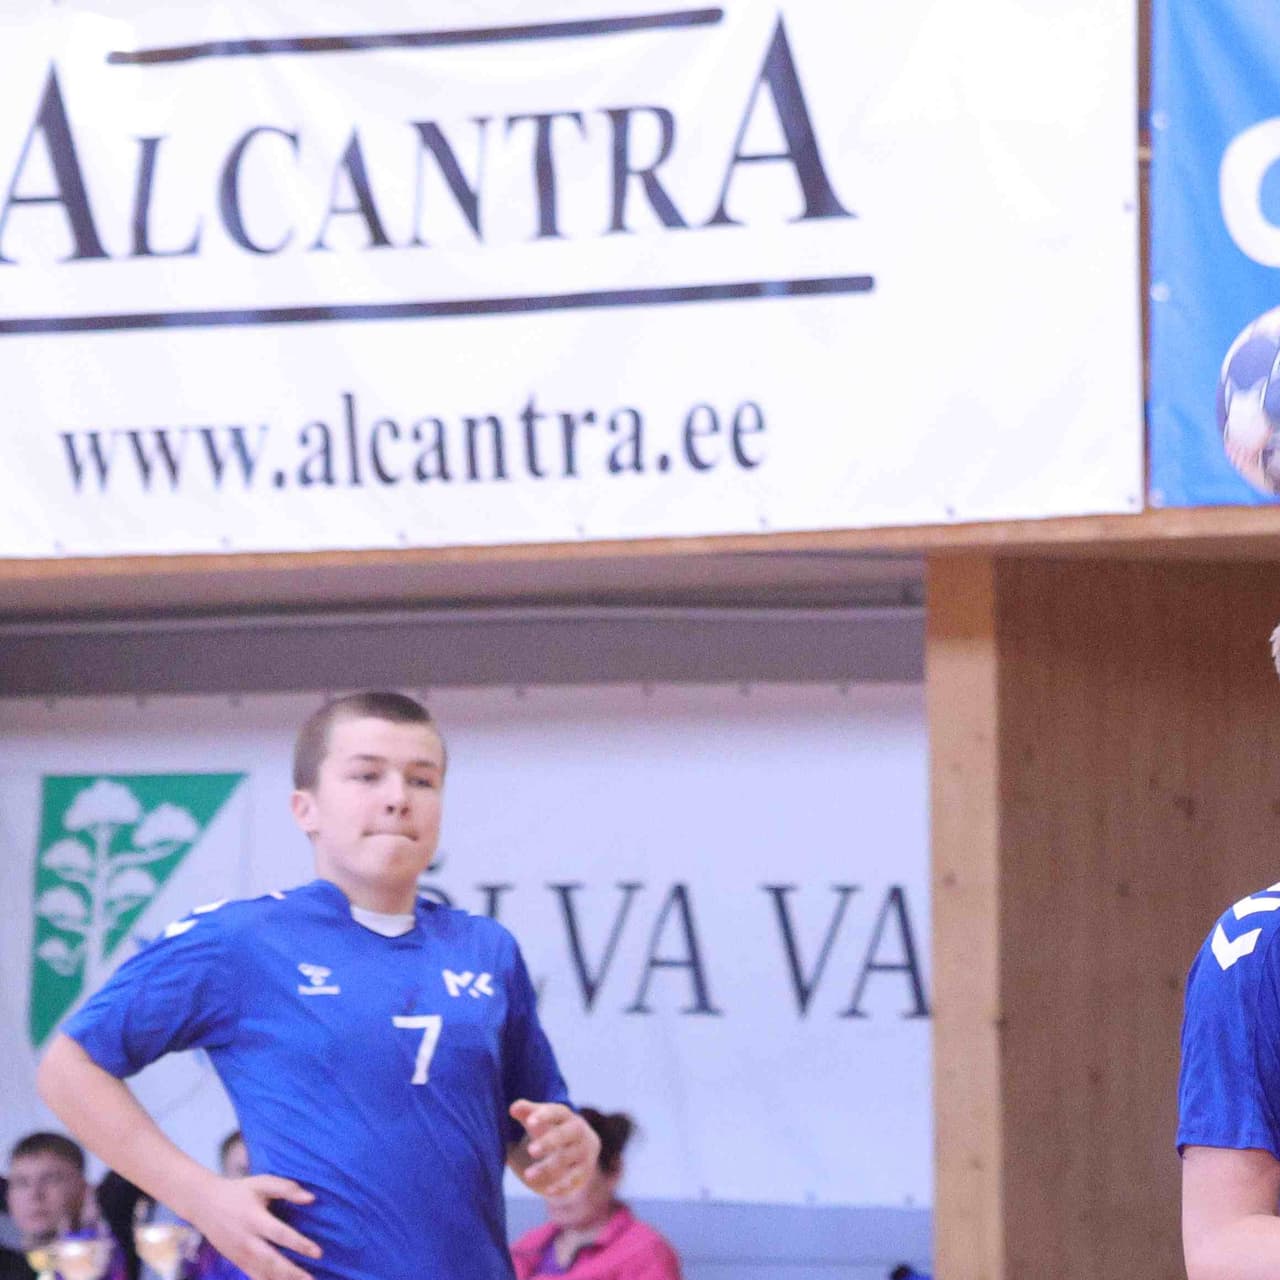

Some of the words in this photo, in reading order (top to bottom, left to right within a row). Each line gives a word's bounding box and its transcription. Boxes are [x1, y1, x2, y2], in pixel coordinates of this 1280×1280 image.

[0, 10, 860, 266] ALCANTRA
[60, 393, 768, 494] www.alcantra.ee
[392, 1015, 442, 1085] 7
